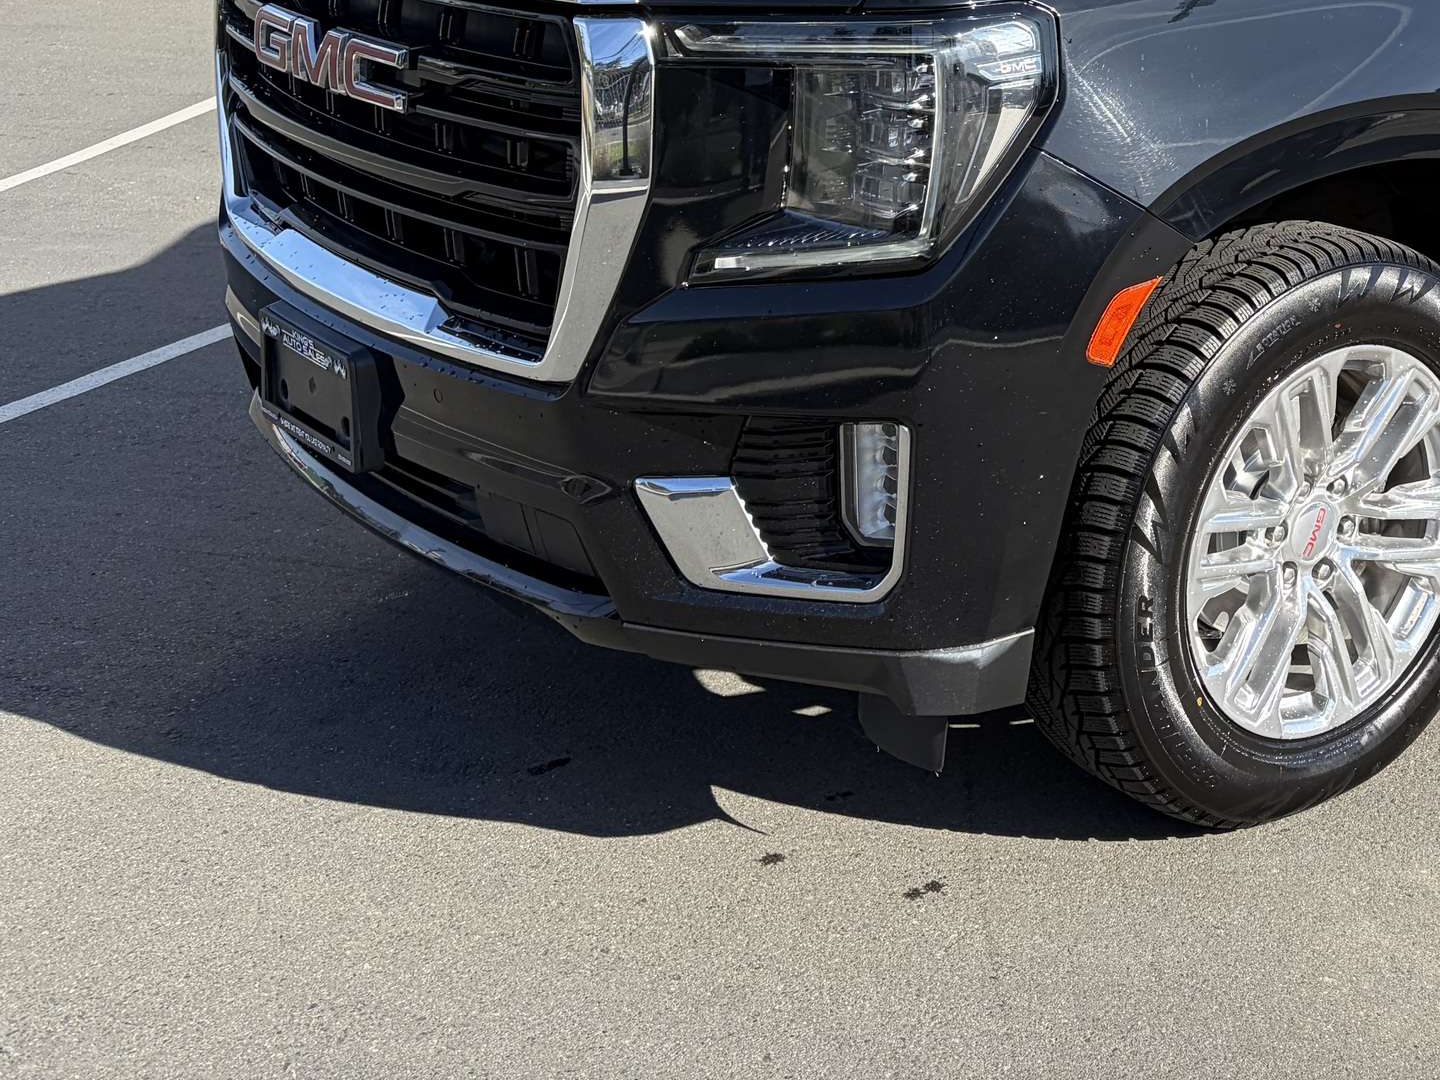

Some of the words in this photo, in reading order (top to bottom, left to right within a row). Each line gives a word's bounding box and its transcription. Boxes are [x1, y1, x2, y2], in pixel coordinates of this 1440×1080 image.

[254, 3, 409, 113] GMC
[283, 334, 303, 350] AUTO
[1302, 507, 1326, 557] GMC
